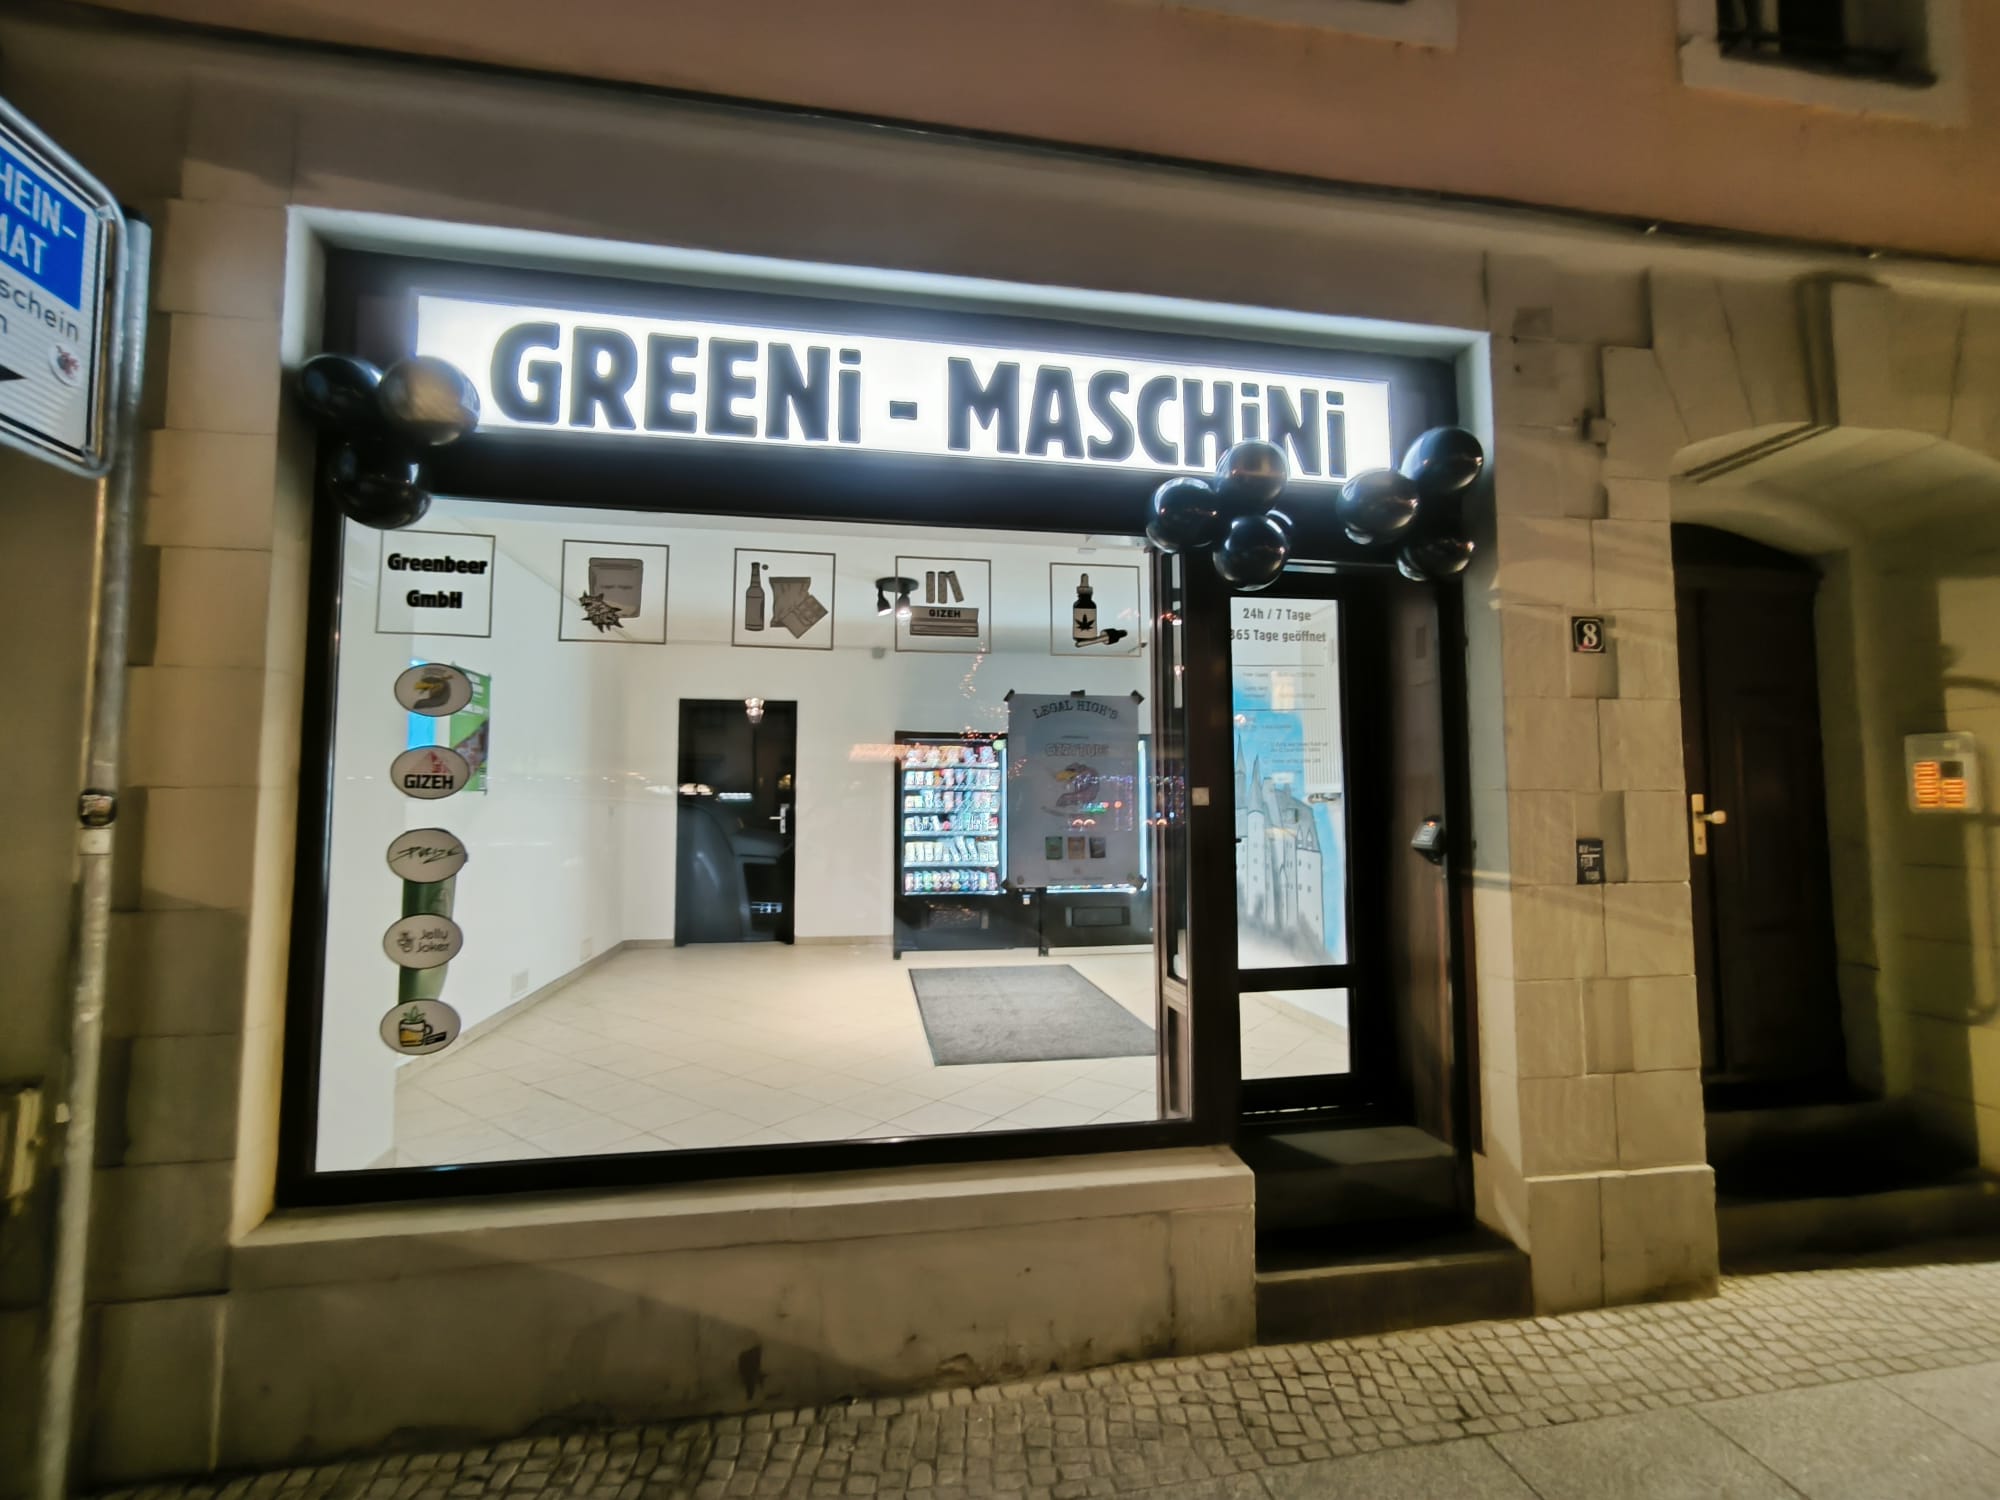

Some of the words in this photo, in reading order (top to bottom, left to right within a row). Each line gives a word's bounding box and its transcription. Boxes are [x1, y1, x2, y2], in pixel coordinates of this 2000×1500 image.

[490, 320, 862, 444] GREENi
[889, 400, 918, 420] -
[387, 552, 488, 575] Greenbeer
[406, 590, 463, 609] GmbH
[928, 608, 961, 618] GIZEH
[1242, 607, 1264, 620] 24h
[1267, 608, 1273, 620] /
[1275, 608, 1283, 620] 7
[1285, 608, 1312, 622] Tage
[1253, 629, 1279, 642] Tage
[1282, 629, 1327, 643] geöffnet
[1582, 623, 1598, 647] 8
[1032, 699, 1074, 719] LEGAL
[404, 773, 454, 790] GIZEH
